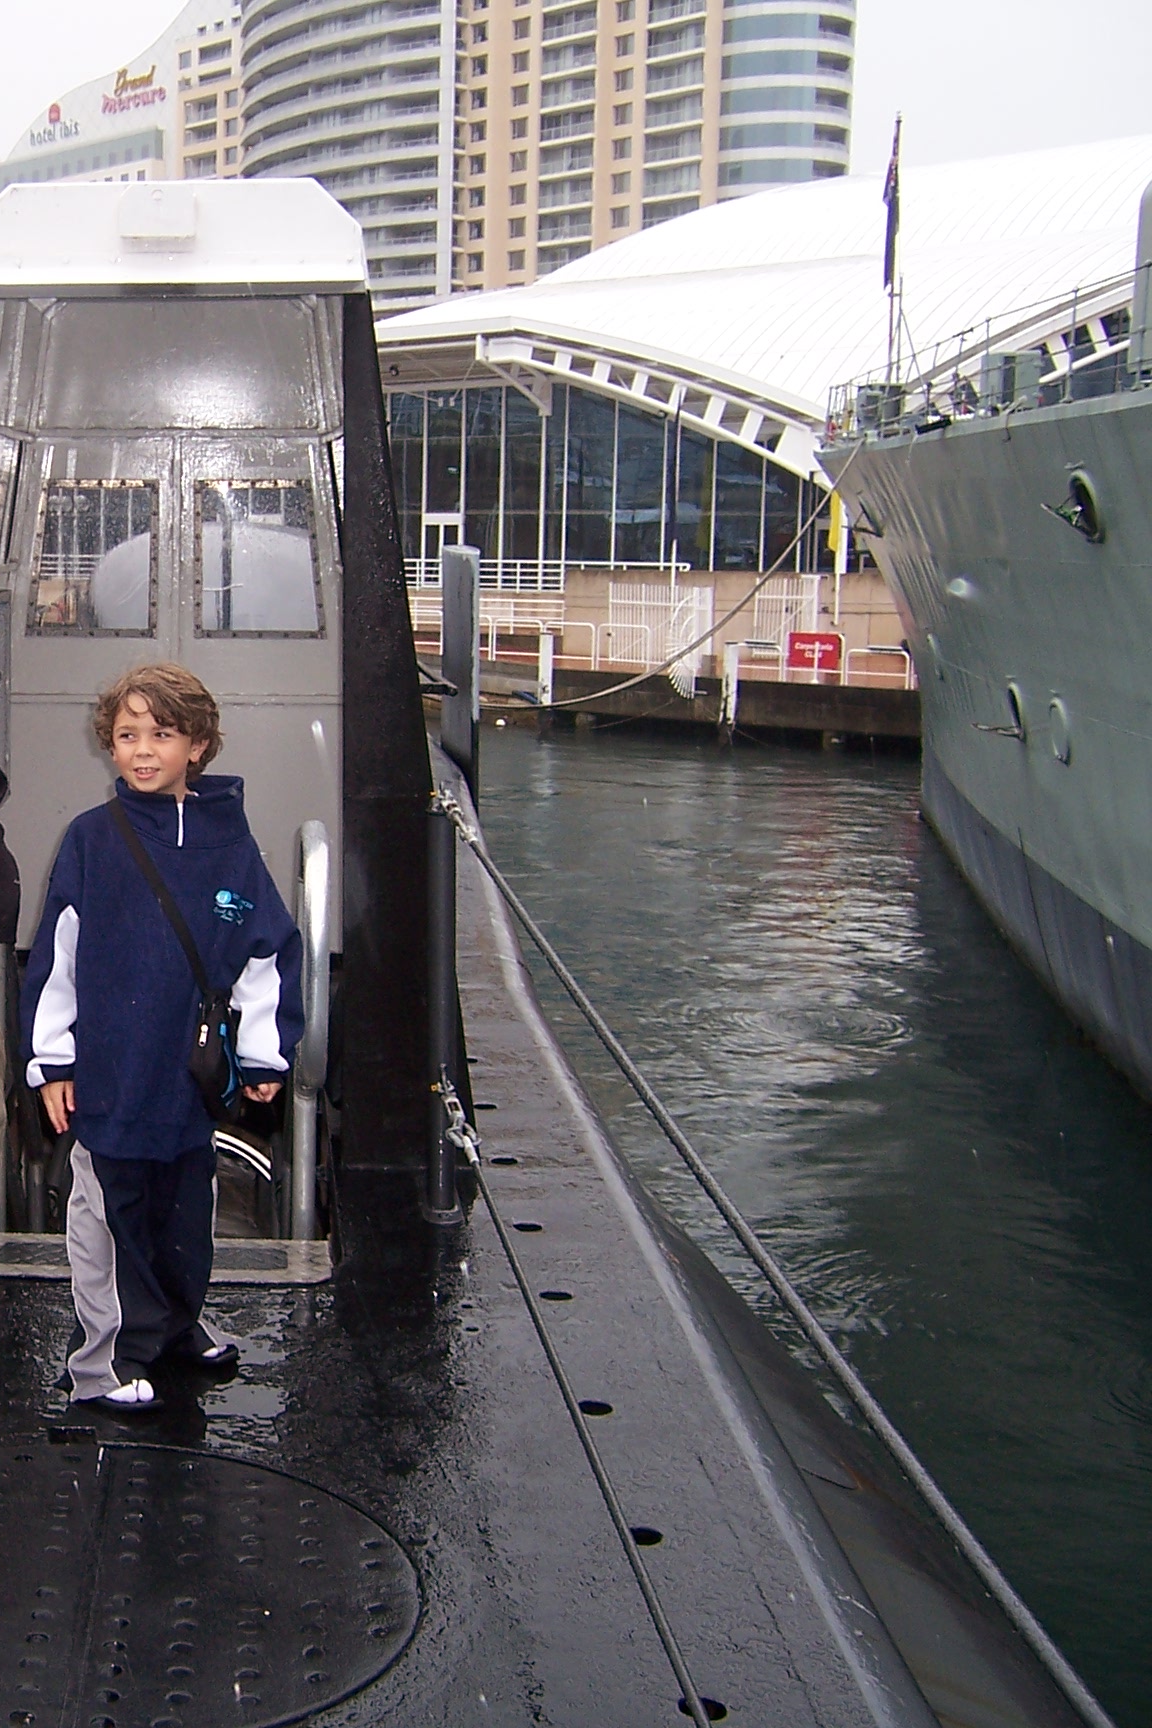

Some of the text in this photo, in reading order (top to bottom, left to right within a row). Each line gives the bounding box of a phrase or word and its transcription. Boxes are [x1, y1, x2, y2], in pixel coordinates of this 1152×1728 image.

[114, 65, 156, 97] Grand
[29, 120, 80, 147] hotel ibis
